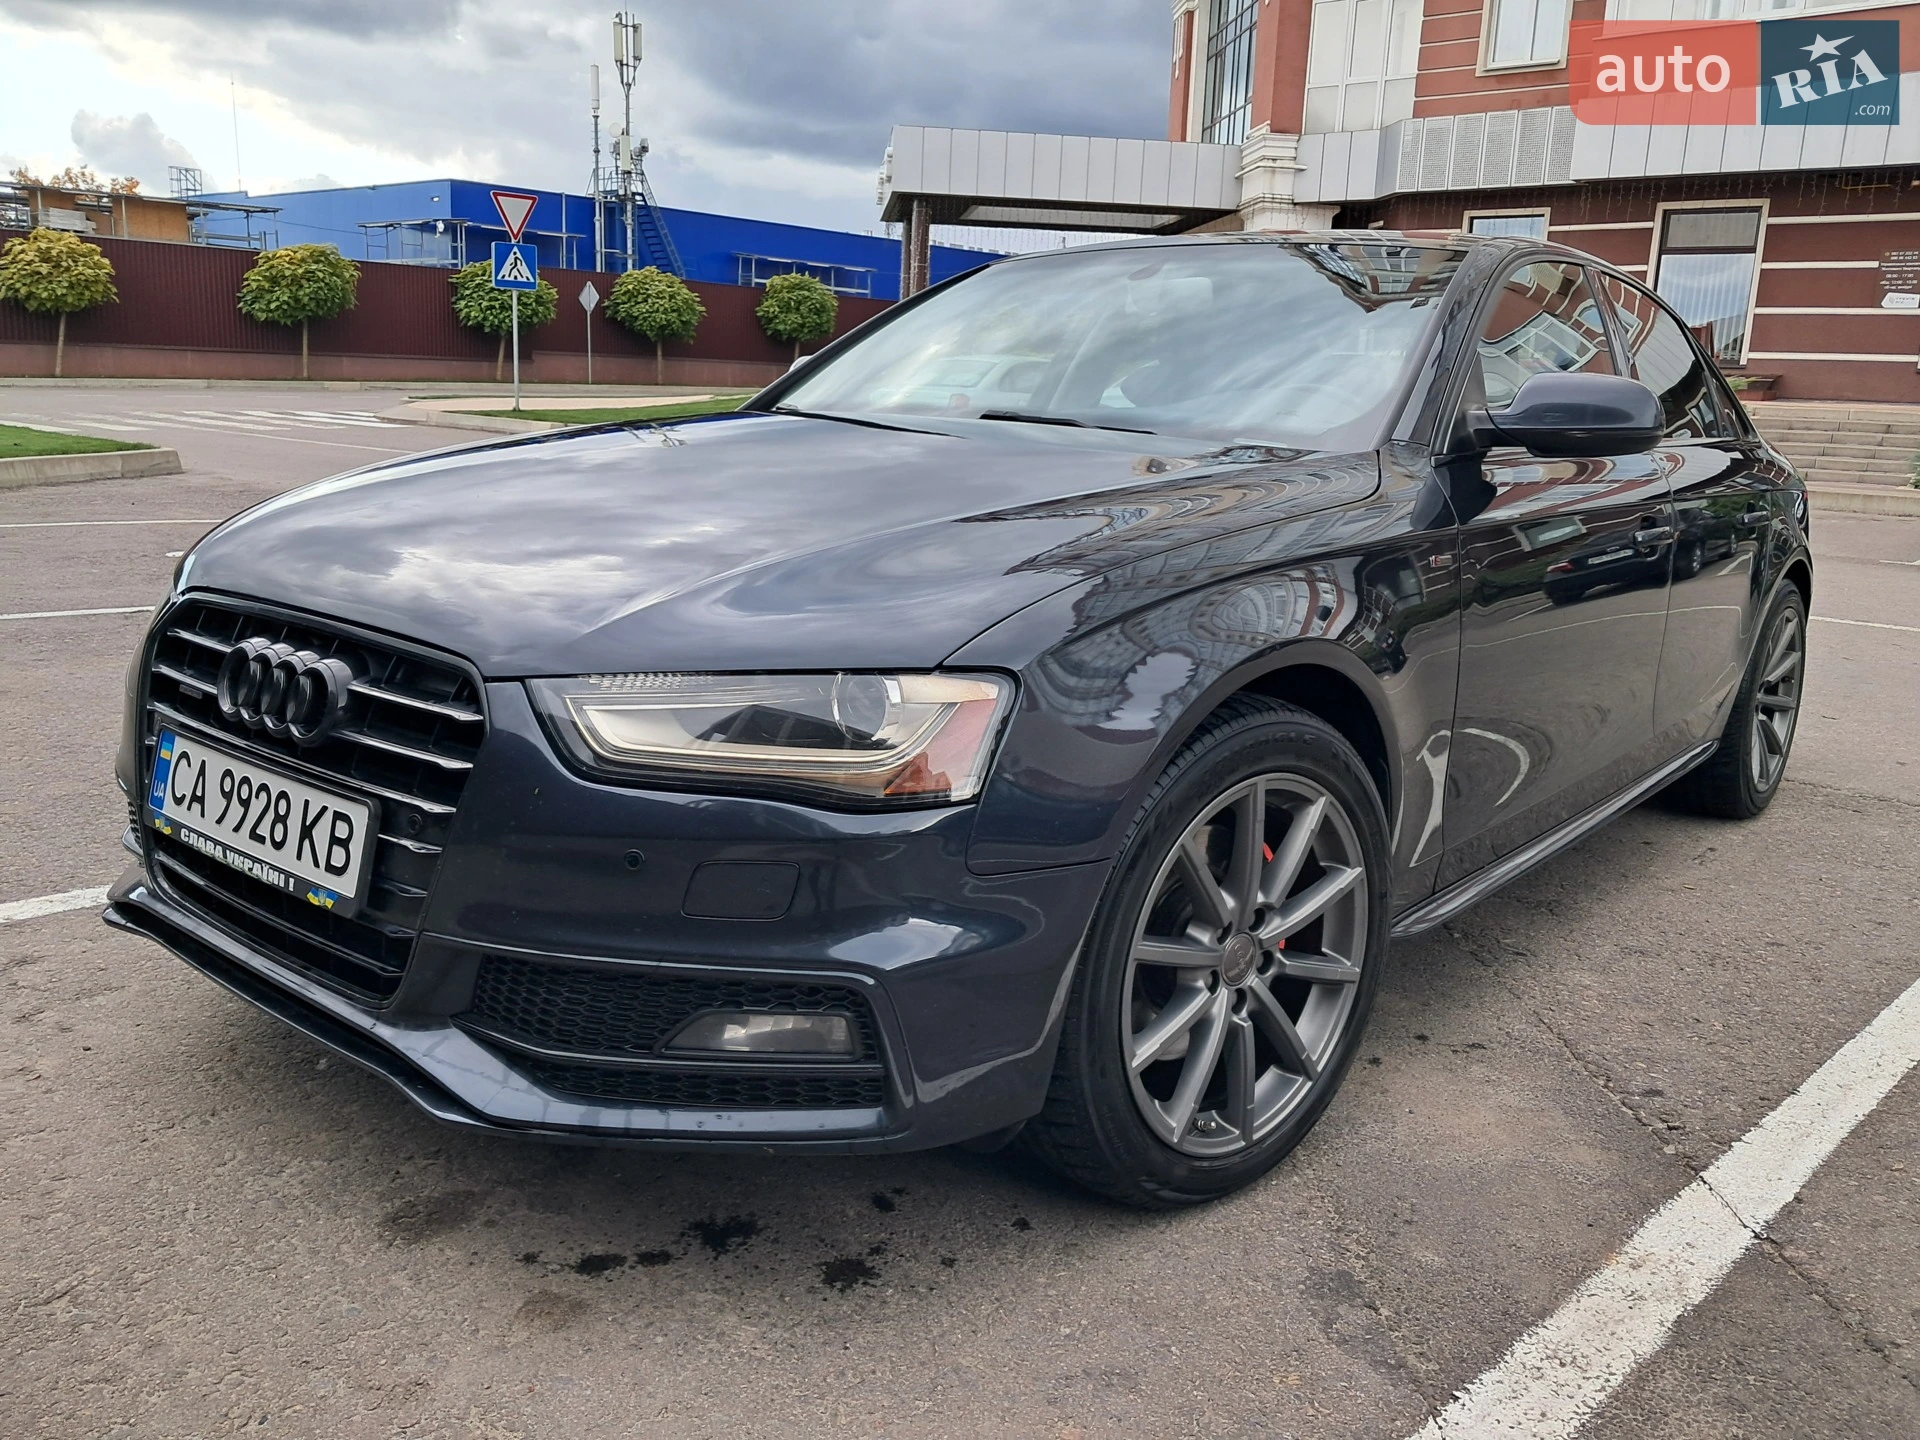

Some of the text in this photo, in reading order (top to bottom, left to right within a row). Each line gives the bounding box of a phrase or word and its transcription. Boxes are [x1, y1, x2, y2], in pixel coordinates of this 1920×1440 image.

[153, 780, 165, 797] UA
[171, 750, 354, 877] CA 9928 KB
[180, 828, 223, 862] СЛАВА
[226, 850, 285, 888] УКРАЇНІ
